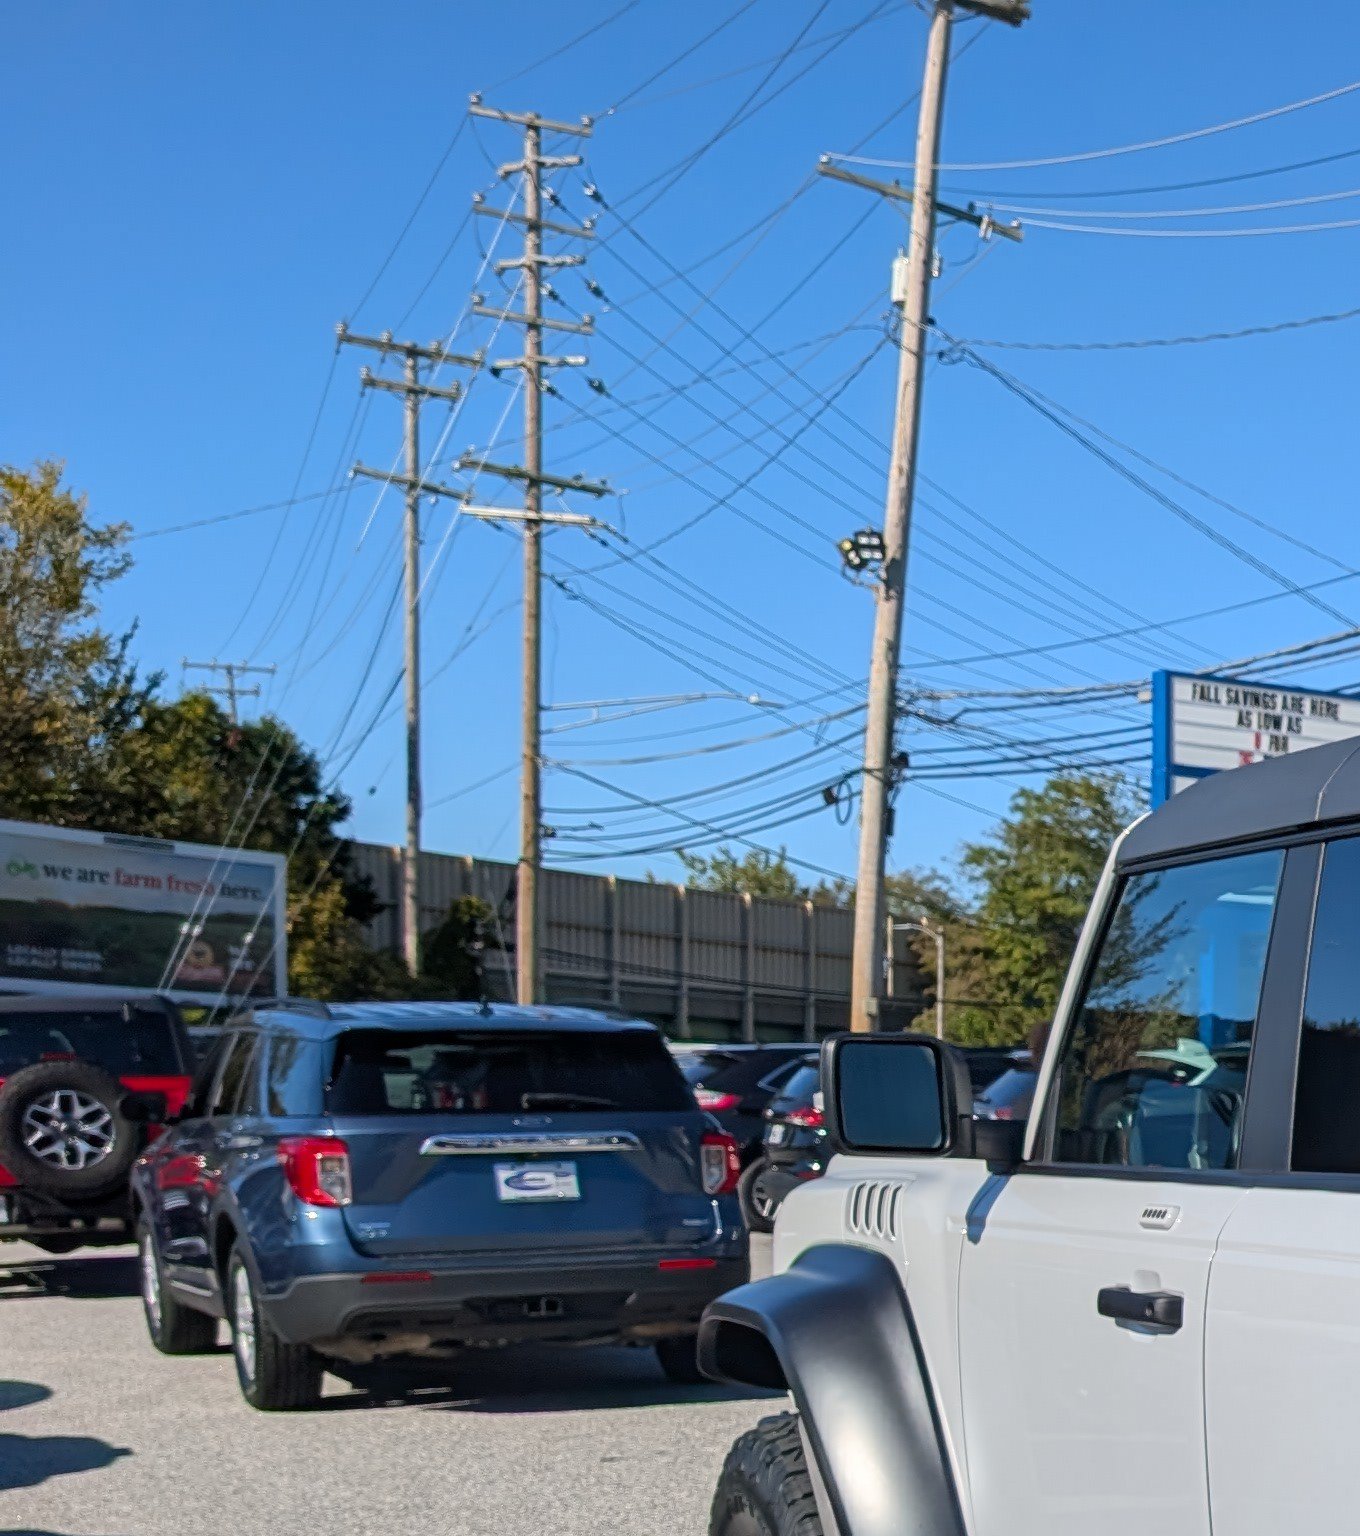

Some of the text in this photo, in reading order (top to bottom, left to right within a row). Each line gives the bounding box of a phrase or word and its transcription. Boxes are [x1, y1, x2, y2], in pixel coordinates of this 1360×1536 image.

[1191, 682, 1340, 721] FALL SAVINGS ARE HERE
[1237, 709, 1302, 735] AS LOW AS
[42, 862, 73, 881] we
[76, 866, 111, 886] are
[114, 867, 163, 890] farm
